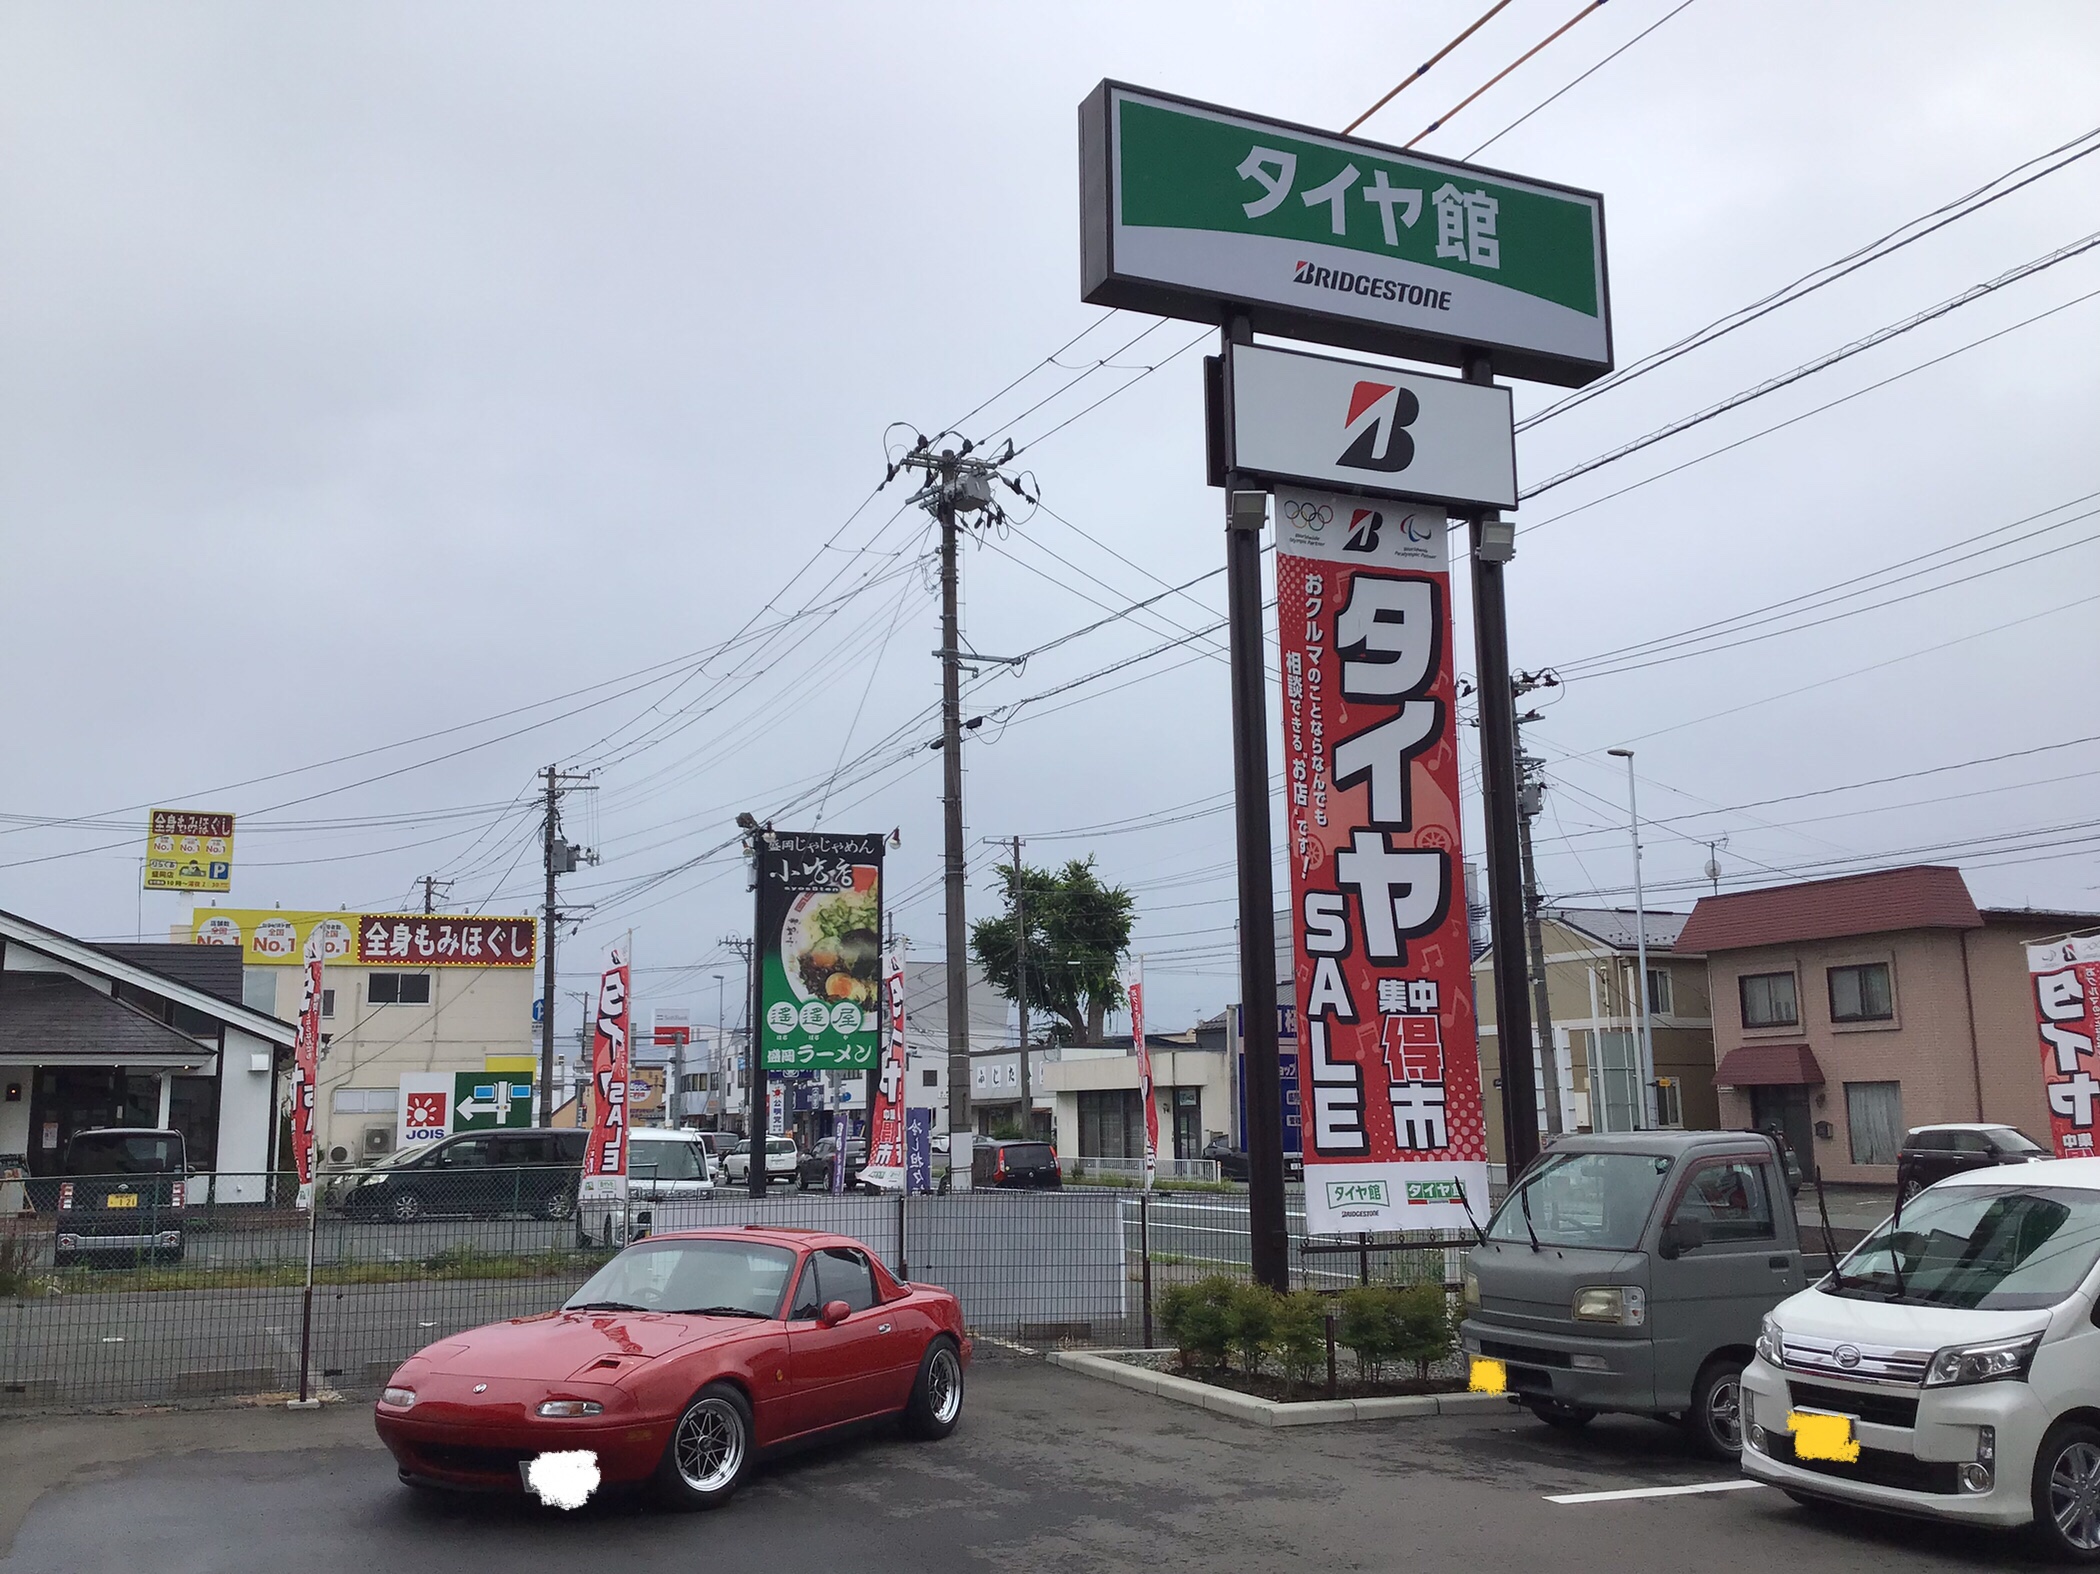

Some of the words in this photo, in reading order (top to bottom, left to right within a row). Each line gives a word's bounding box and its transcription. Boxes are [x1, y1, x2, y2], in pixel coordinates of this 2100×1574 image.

[1235, 145, 1501, 269] タイヤ館
[1293, 260, 1452, 311] BRIDGESTONE
[1305, 573, 1328, 828] おクルマのことならなんでも
[1334, 574, 1446, 960] タイヤ
[154, 813, 231, 836] 全身もみほぐし
[154, 843, 174, 851] No.1
[180, 844, 200, 853] No.1
[768, 836, 874, 855] 盛岡じゃじゃめん
[253, 937, 297, 953] No.1
[365, 922, 529, 958] 全身もみほぐし
[1378, 979, 1438, 1012] 集中
[1304, 893, 1365, 1149] SALE
[767, 1044, 872, 1064] 盛岡ラーメン
[773, 1099, 782, 1124] 公明党
[406, 1128, 445, 1140] JOIS
[1334, 1184, 1382, 1202] タイヤ館
[1341, 1210, 1379, 1218] BRIDGESTONE
